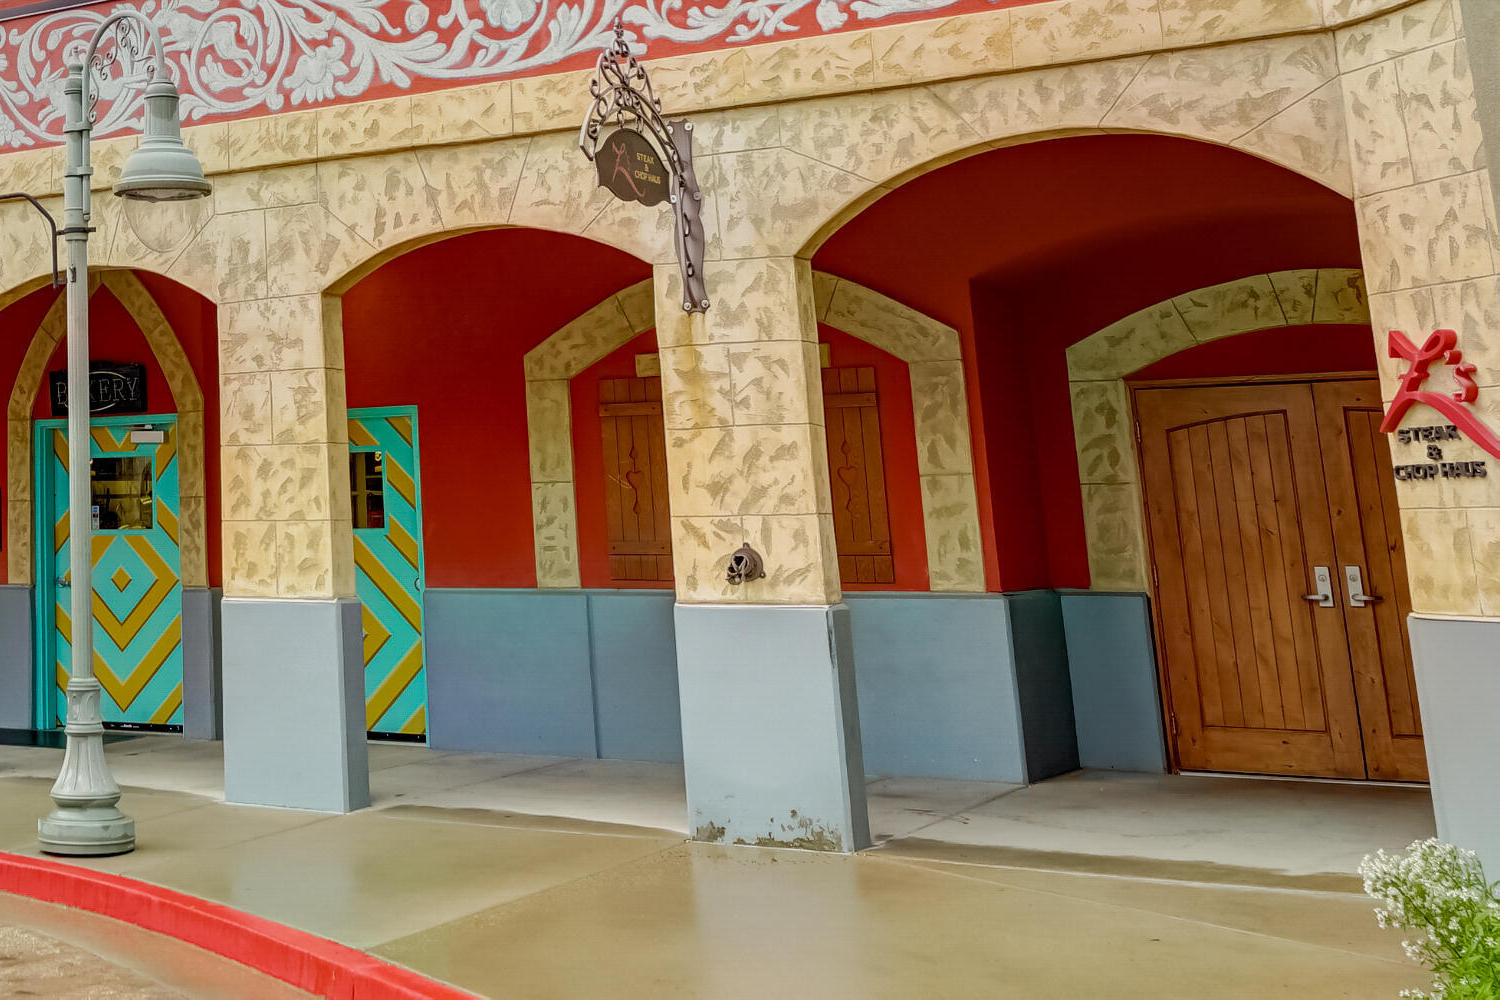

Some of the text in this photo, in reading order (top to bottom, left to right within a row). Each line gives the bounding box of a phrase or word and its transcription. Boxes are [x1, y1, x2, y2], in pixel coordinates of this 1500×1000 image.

[636, 152, 655, 165] STEAK
[644, 163, 650, 172] &
[634, 170, 648, 180] CHOP
[1398, 425, 1462, 444] STEAK
[1426, 444, 1443, 460] &
[1394, 461, 1487, 481] CHOP HAUS
